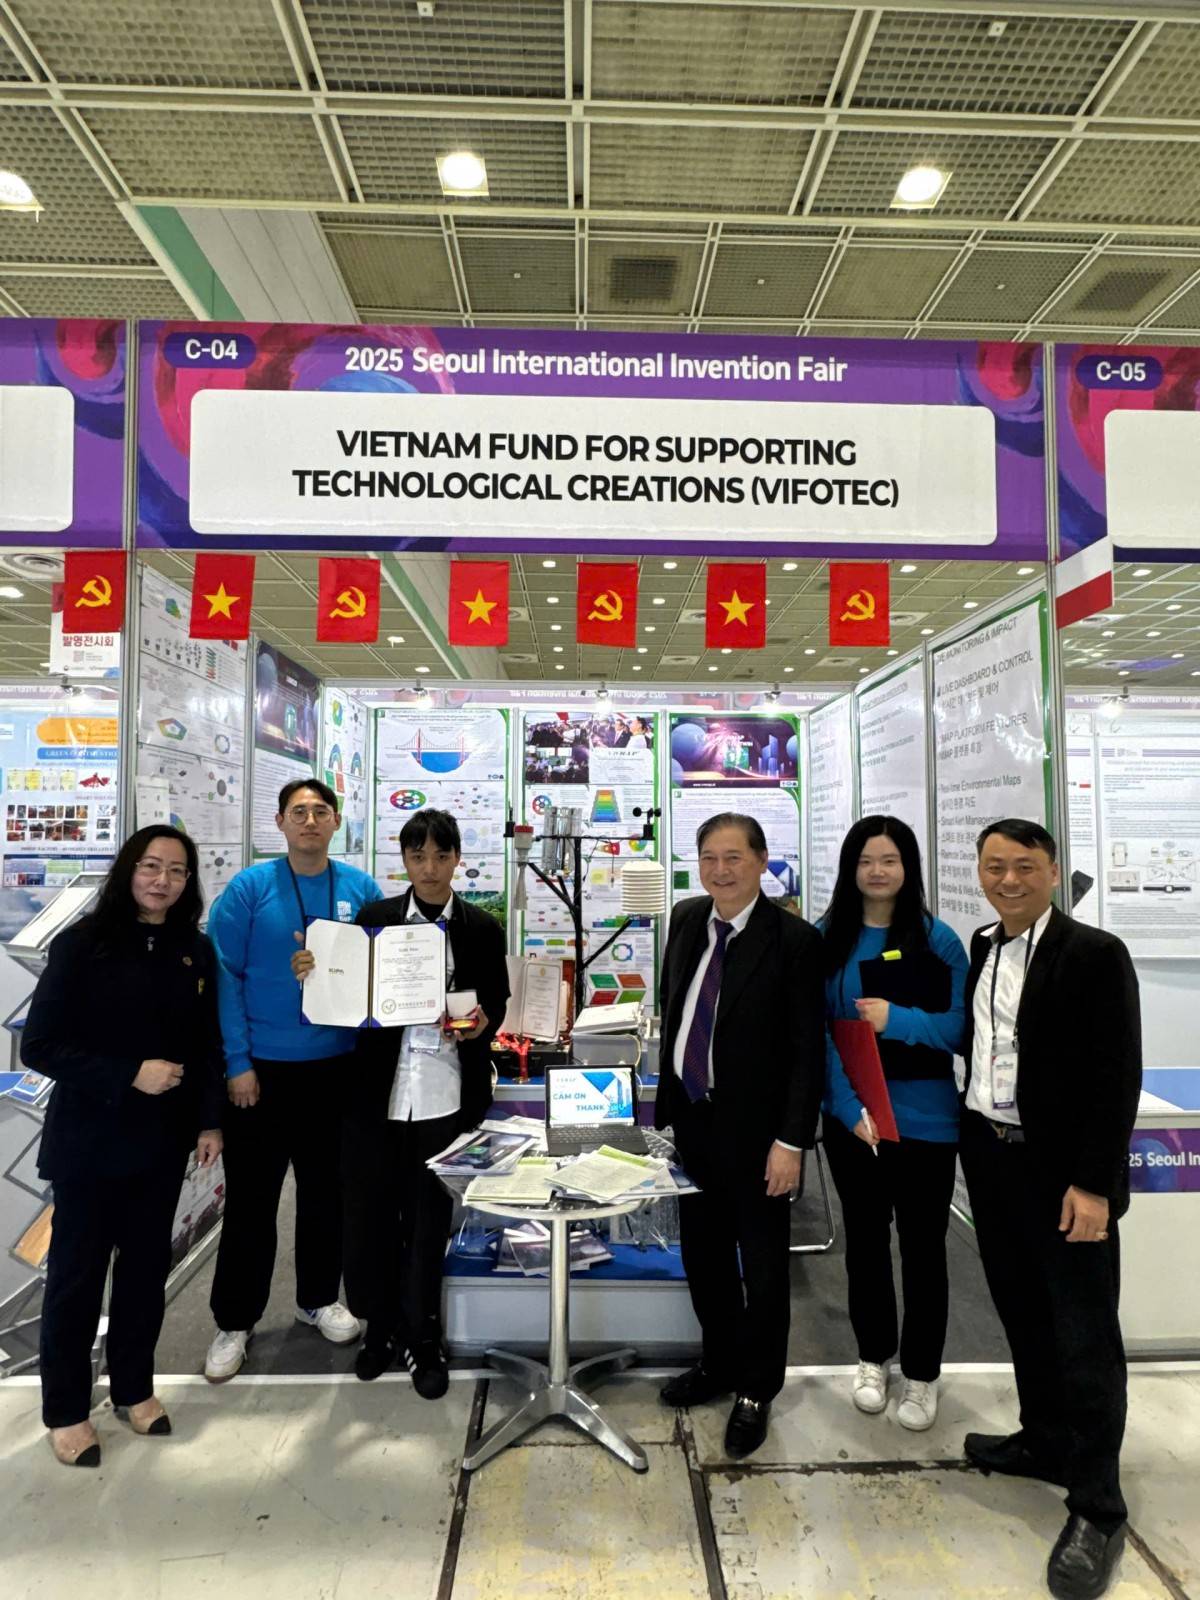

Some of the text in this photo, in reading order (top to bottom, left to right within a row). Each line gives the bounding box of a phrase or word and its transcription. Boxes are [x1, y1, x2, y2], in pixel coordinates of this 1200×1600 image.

[184, 338, 239, 361] C-04
[344, 346, 848, 382] 2025 Seoul International Invention Fair
[1096, 360, 1146, 382] C-05
[336, 429, 856, 466] VIETNAM FUND FOR SUPPORTING
[292, 469, 899, 508] TECHNOLOGICAL CREATIONS (VIFOTEC)
[63, 635, 114, 648] 발명전시회
[998, 650, 1034, 673] CONTROL
[961, 776, 1002, 791] Environmental
[1002, 774, 1022, 788] Maps
[1146, 1151, 1186, 1167] Seoul
